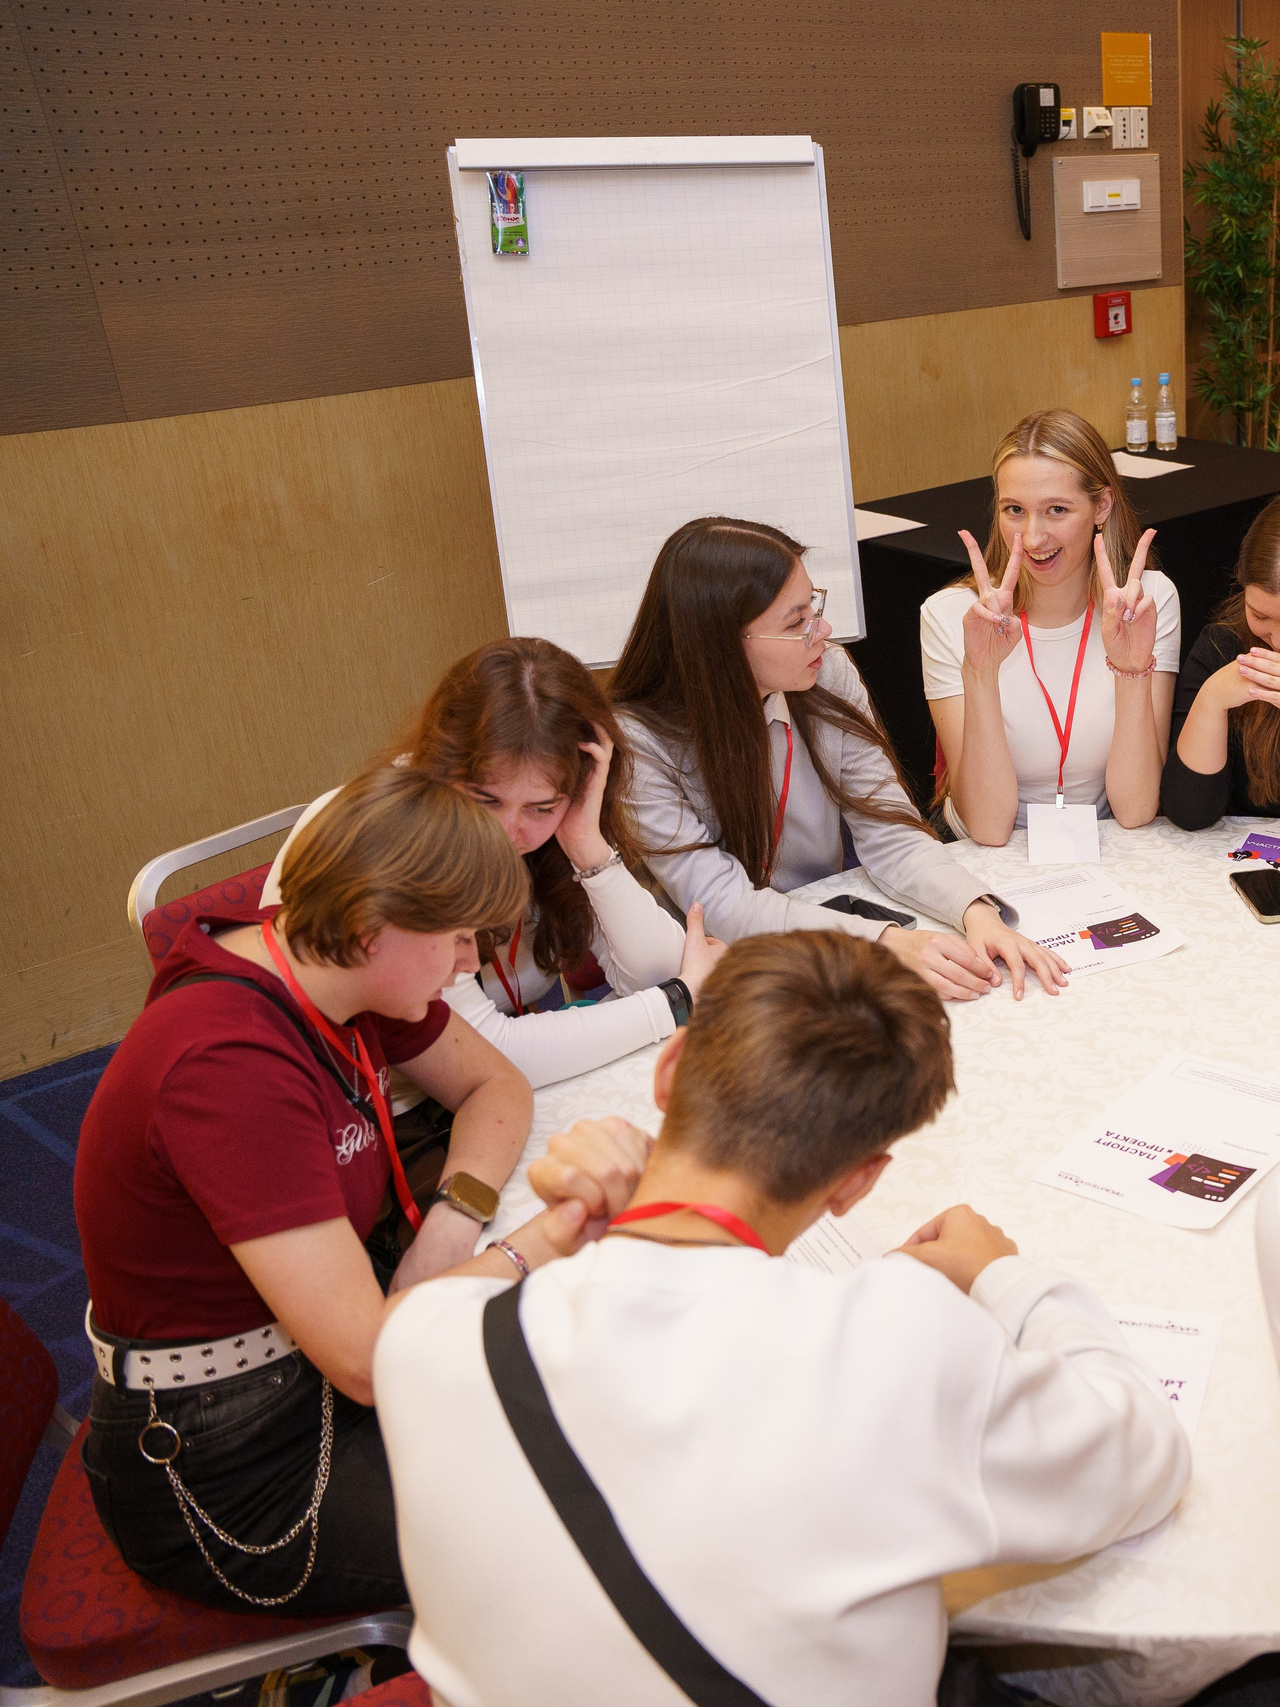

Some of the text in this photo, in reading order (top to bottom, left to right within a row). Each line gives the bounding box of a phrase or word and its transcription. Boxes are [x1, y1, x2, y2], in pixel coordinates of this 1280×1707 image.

[1035, 933, 1070, 946] ПРОЕ
[1043, 938, 1076, 950] ПАСП
[1093, 1137, 1157, 1161] ПАСПОРТ
[1105, 1130, 1165, 1153] ПРОЕКТА
